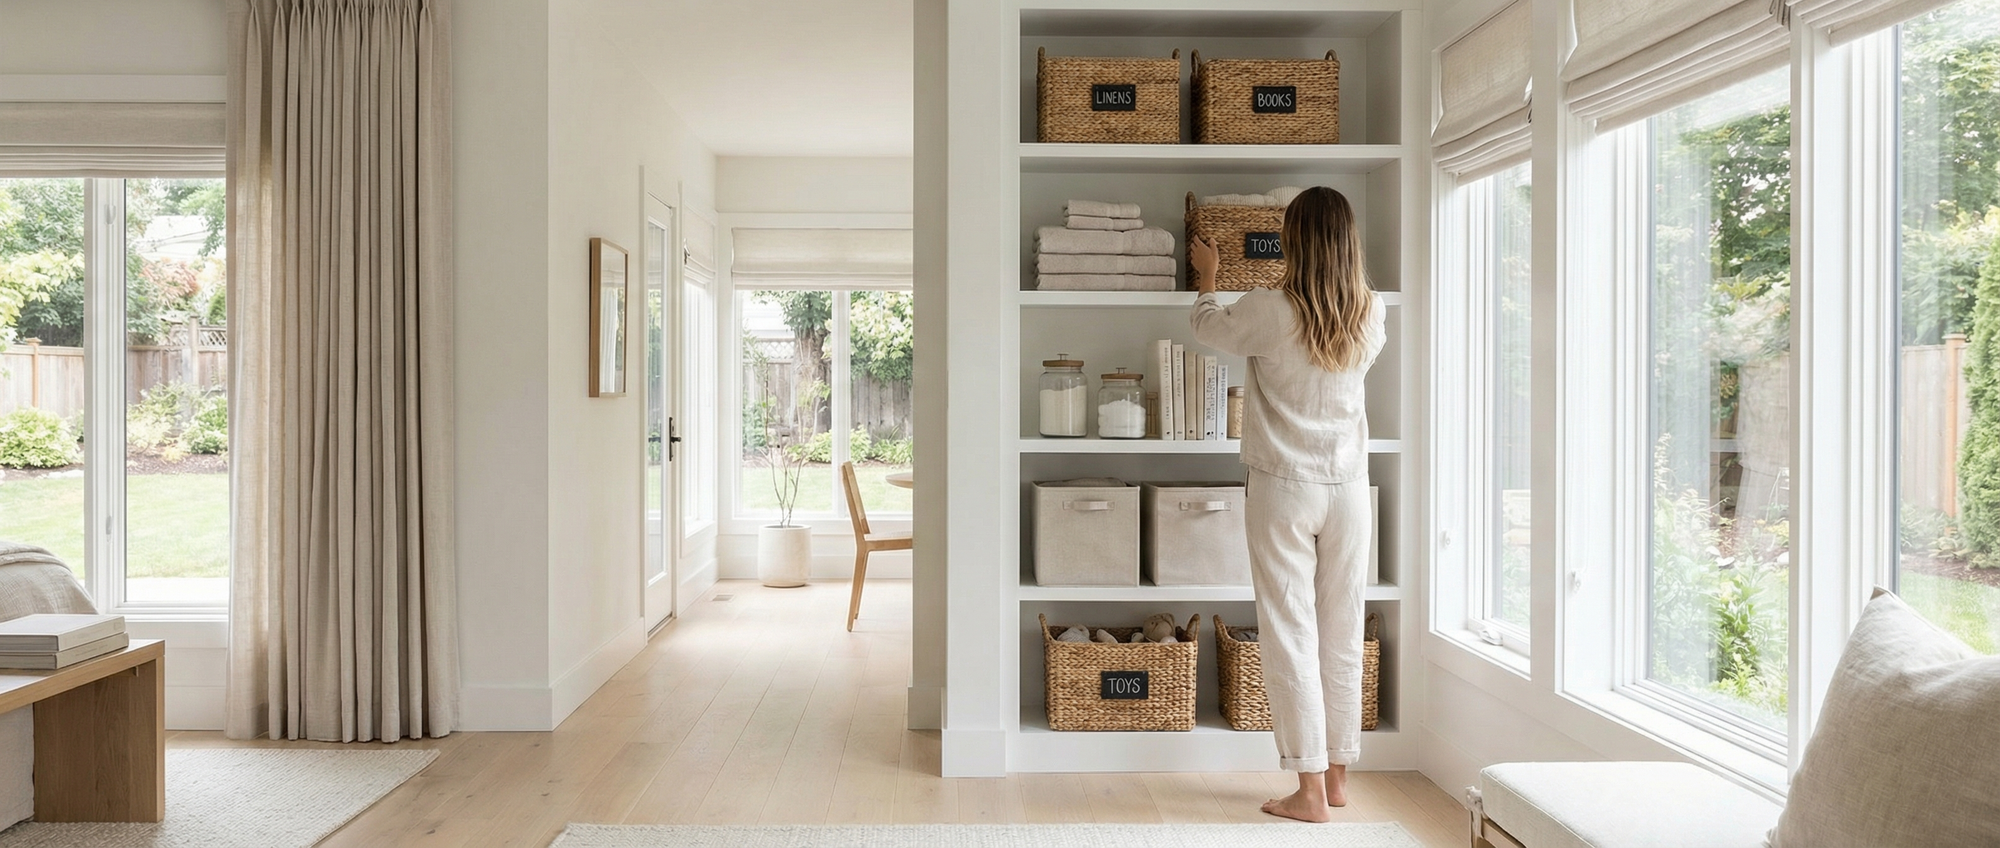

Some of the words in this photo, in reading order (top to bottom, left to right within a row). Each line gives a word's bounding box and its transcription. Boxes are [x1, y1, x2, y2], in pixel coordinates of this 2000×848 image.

[1096, 91, 1131, 105] LINENS
[1258, 93, 1292, 107] BOOKS
[1251, 239, 1280, 253] TOYS
[1107, 678, 1140, 693] TOYS
